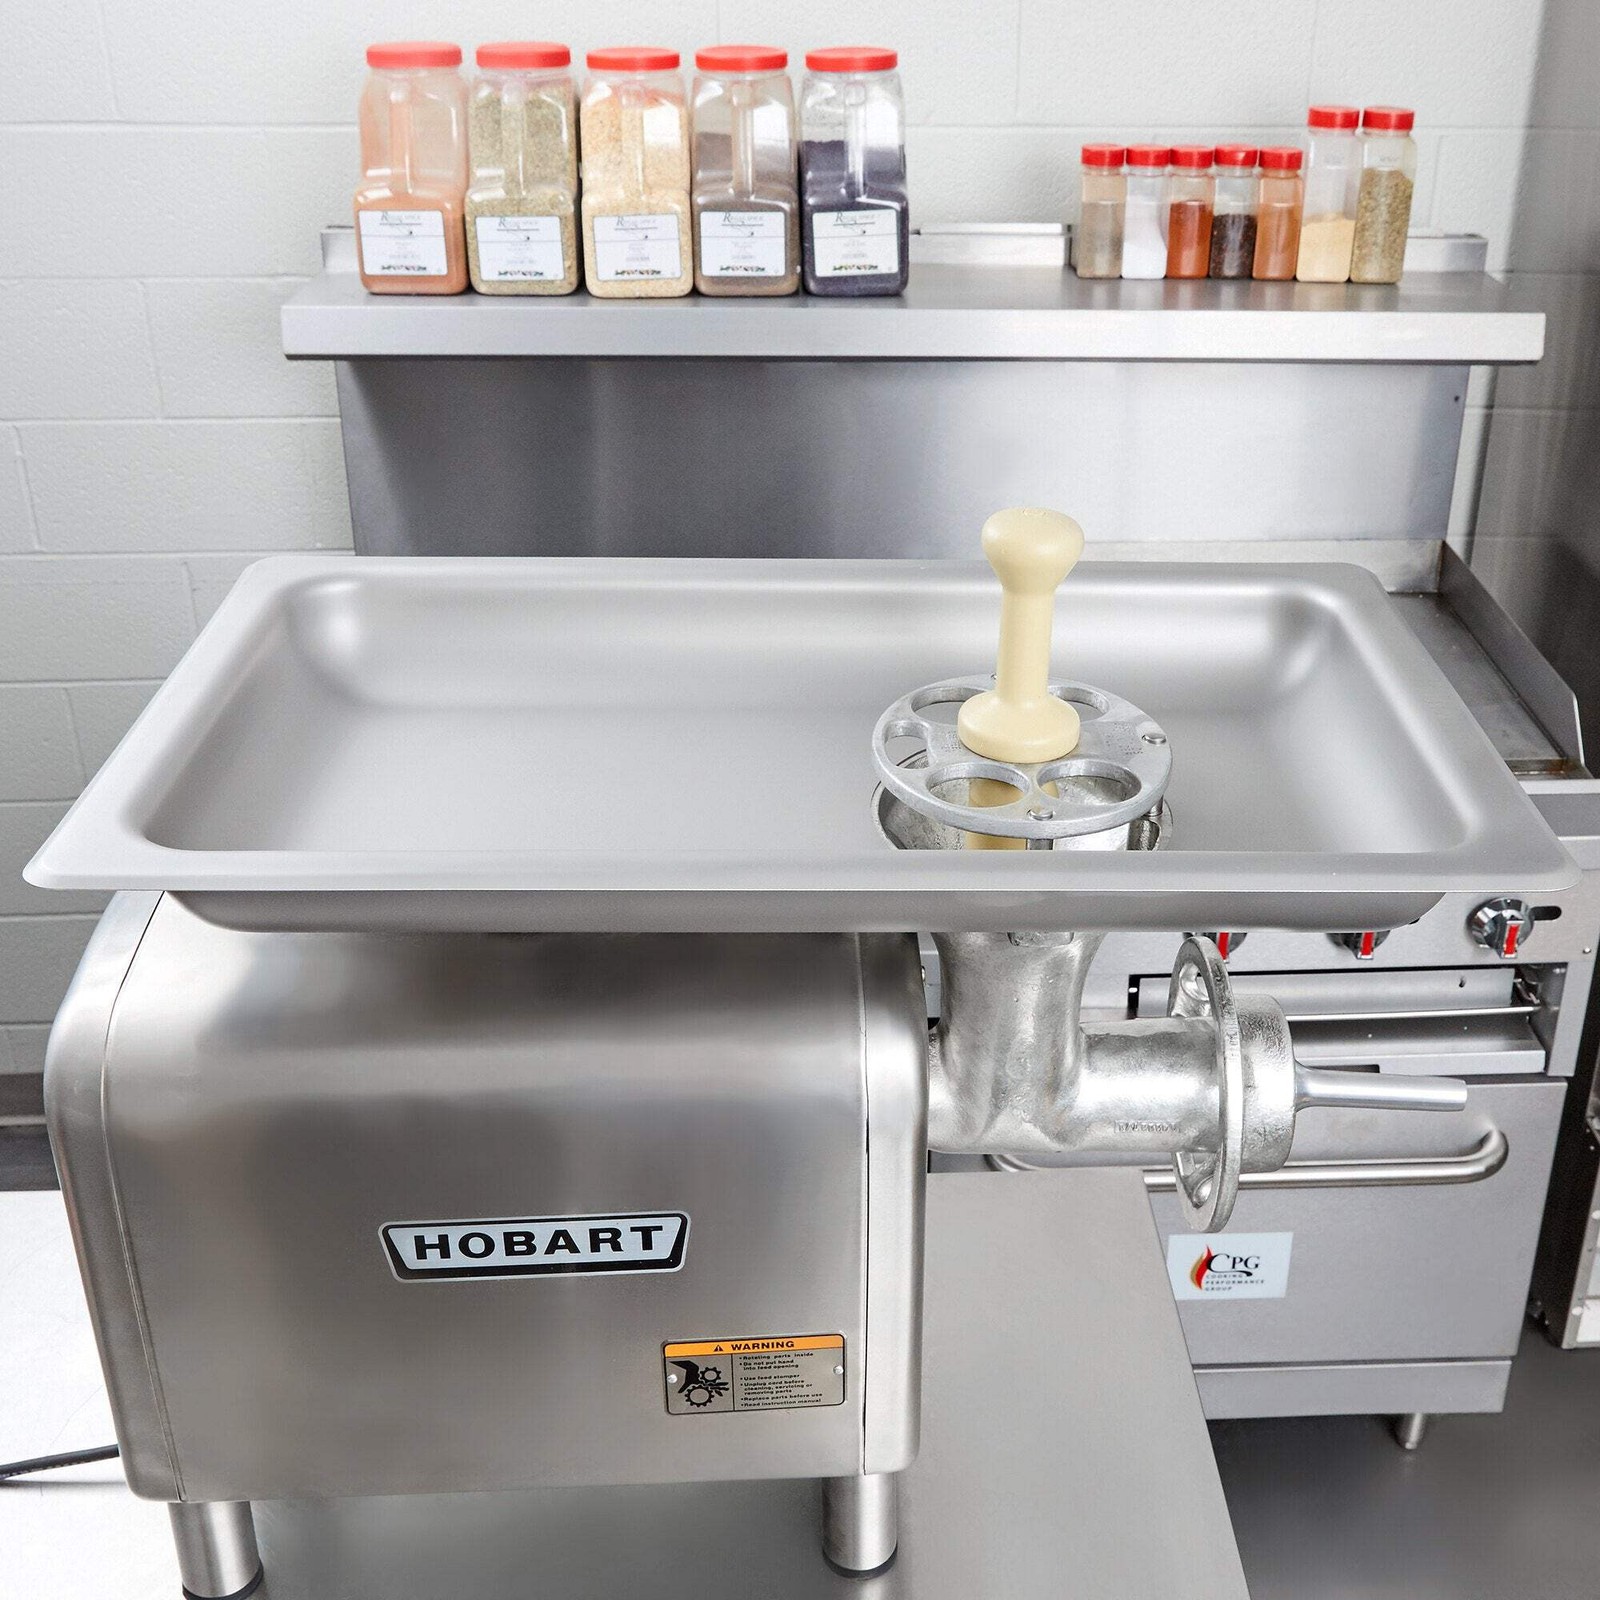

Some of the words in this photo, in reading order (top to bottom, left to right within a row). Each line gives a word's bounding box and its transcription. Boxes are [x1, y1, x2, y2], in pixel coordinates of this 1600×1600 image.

[414, 1225, 664, 1261] HOBART
[1206, 1253, 1260, 1277] CPG
[731, 1341, 795, 1350] WARNING
